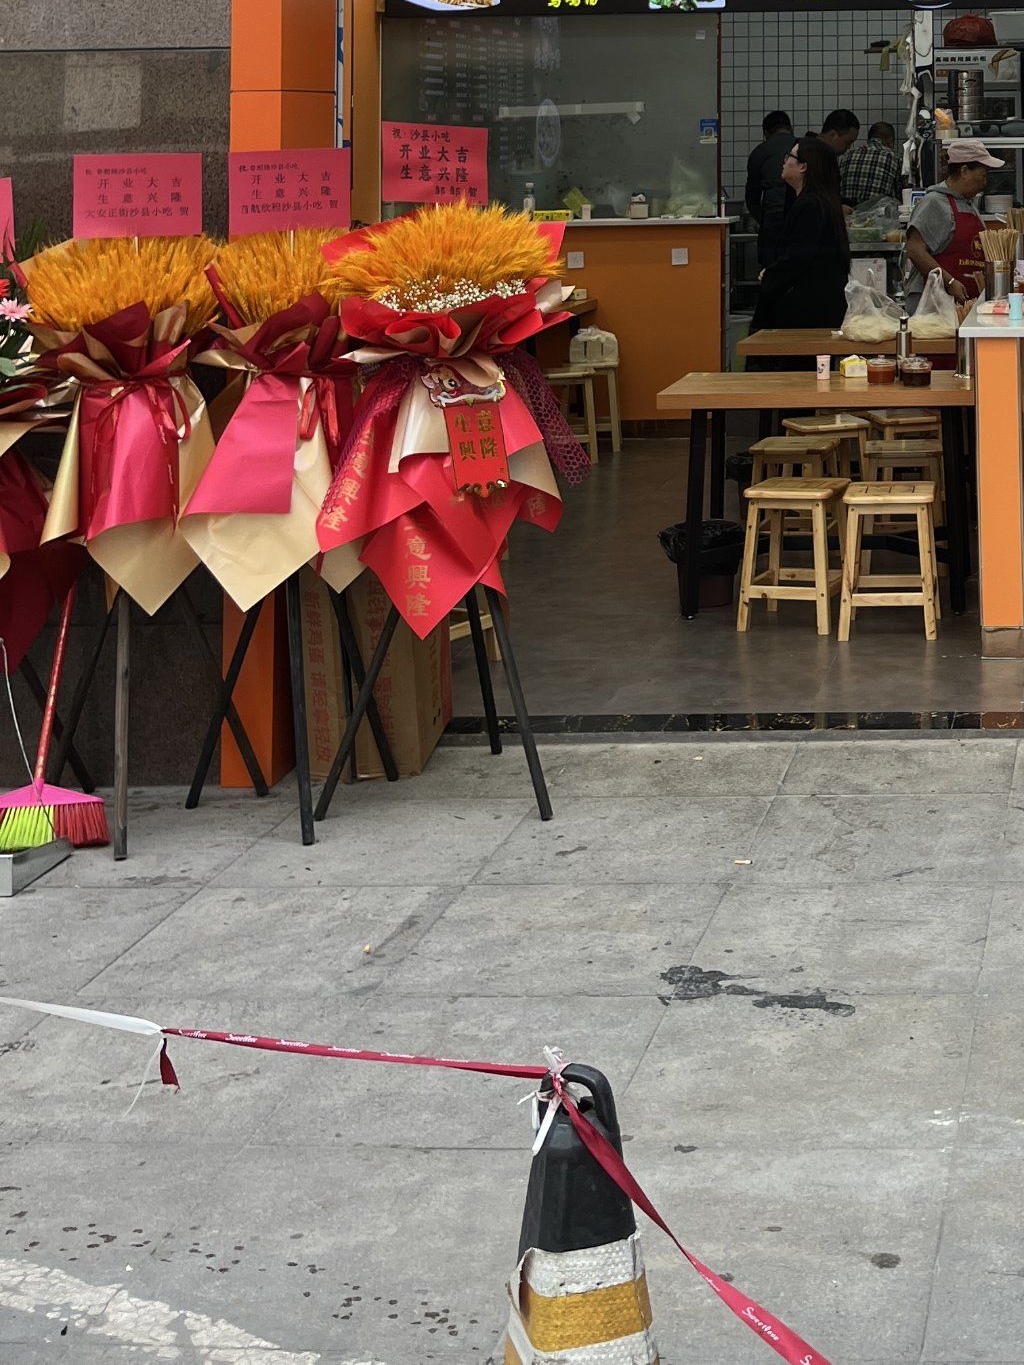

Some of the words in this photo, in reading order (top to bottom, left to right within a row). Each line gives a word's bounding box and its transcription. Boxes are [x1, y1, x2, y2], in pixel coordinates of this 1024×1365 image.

[399, 144, 469, 163] 开业大吉
[251, 171, 331, 185] 开业大吉
[400, 164, 469, 183] 生意兴隆
[97, 177, 182, 190] 开业大吉
[251, 185, 332, 200] 生意兴隆
[97, 192, 182, 205] 生意兴隆
[454, 410, 494, 432] 生意
[459, 437, 498, 461] 興隆
[404, 525, 432, 616] 意興隆
